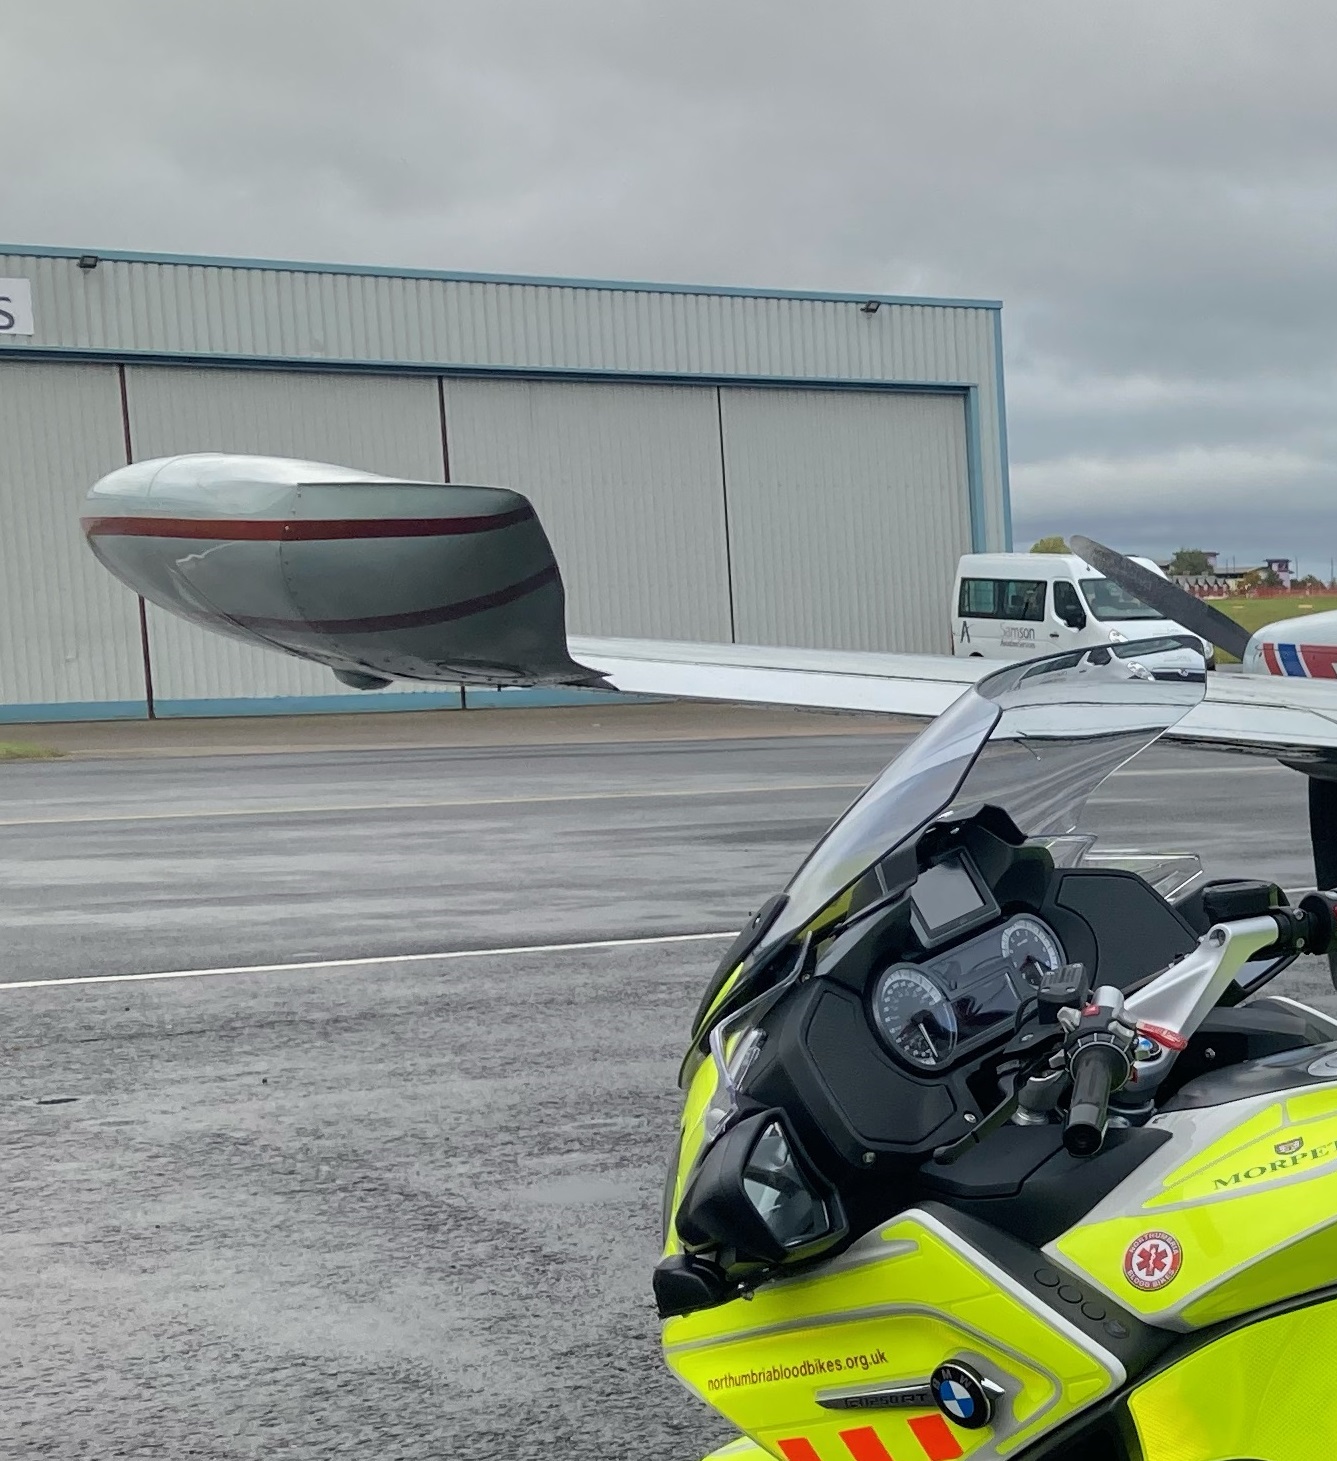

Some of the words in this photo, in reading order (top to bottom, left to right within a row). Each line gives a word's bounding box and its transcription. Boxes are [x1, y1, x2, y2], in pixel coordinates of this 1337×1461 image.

[1128, 1232, 1179, 1254] NORTHUMBRIA
[1126, 1269, 1151, 1288] BLOOD
[1151, 1268, 1175, 1288] BIKES
[707, 1348, 888, 1391] northumbriabloodbikes.org.uk
